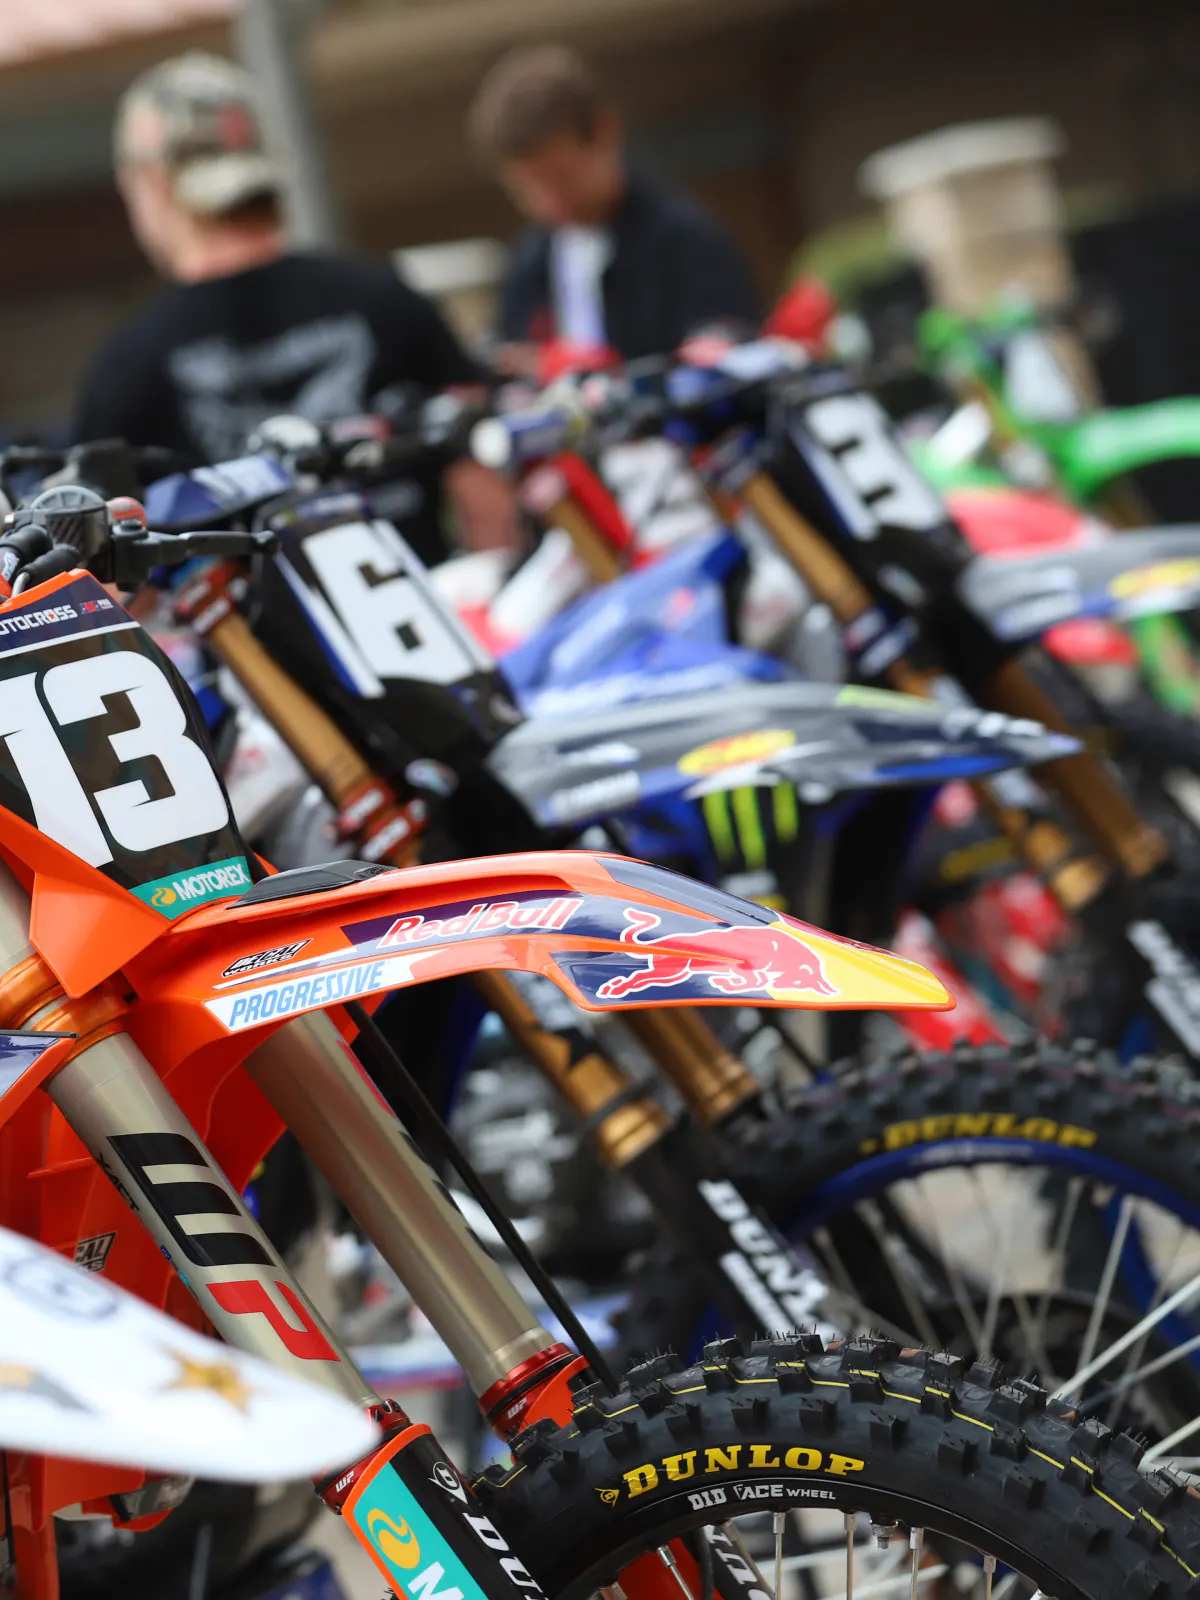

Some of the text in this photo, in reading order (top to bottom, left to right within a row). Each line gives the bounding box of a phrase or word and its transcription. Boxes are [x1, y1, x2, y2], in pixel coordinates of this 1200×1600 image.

[301, 520, 476, 686] 6
[172, 863, 251, 901] MOTOREX
[228, 960, 388, 1028] PROGRESSIVE
[883, 1112, 1098, 1150] DUNLOP
[623, 1444, 865, 1499] DUNLOP
[786, 1488, 836, 1500] WHEEL
